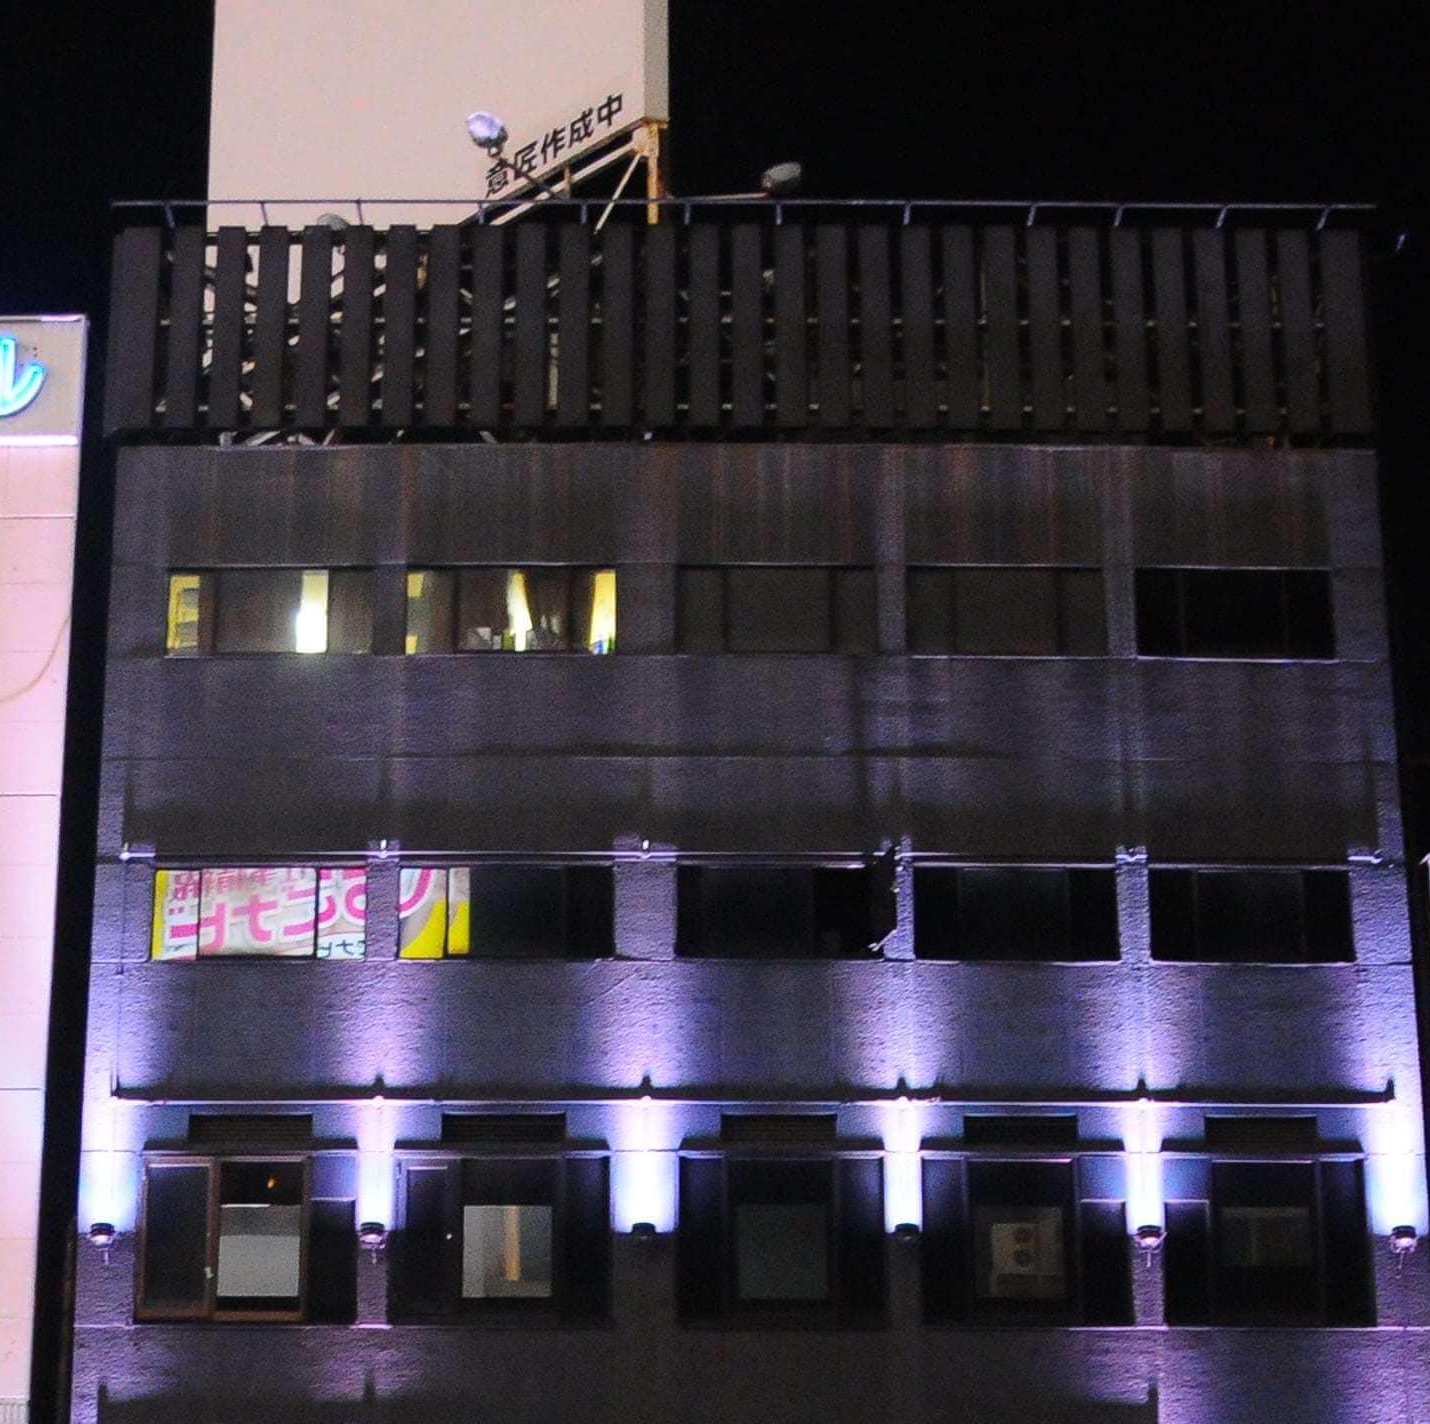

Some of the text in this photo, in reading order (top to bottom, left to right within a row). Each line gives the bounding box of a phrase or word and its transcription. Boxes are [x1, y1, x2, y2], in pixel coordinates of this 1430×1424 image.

[485, 93, 624, 197] 意匠作成中
